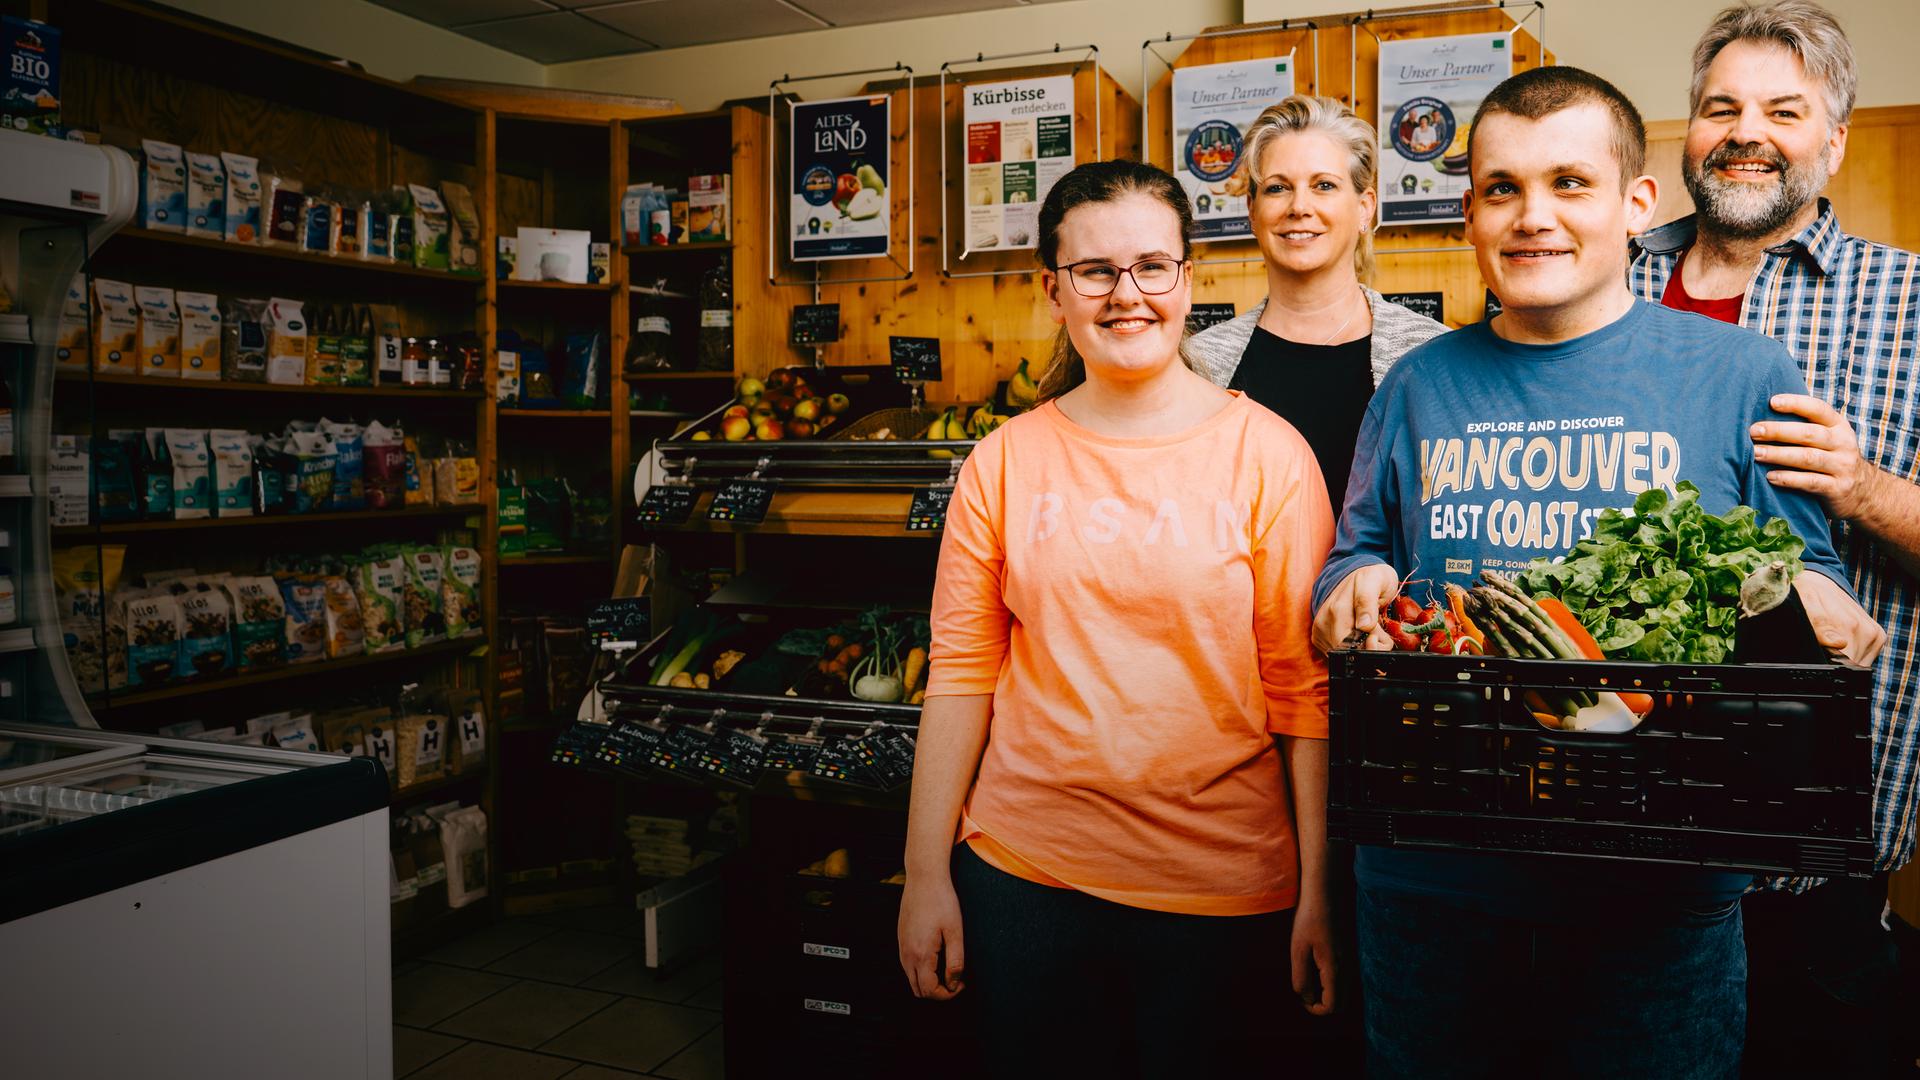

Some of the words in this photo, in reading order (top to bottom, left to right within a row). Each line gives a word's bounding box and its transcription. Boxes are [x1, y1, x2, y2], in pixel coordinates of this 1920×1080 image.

[10, 53, 50, 80] BIO
[1399, 64, 1439, 80] Unser
[1443, 61, 1495, 76] Partner
[972, 87, 1046, 107] Kürbisse
[1191, 90, 1229, 105] Unser
[1231, 86, 1279, 100] Partner
[1010, 101, 1067, 115] entdecken
[815, 113, 853, 129] ALTES
[1467, 421, 1525, 433] EXPLORE
[1527, 420, 1556, 432] AND
[1560, 416, 1624, 430] DISCOVER
[1420, 431, 1681, 506] VANCOUVER
[1430, 504, 1483, 540] EAST
[1486, 498, 1579, 550] COAST
[1482, 558, 1503, 567] KEEP
